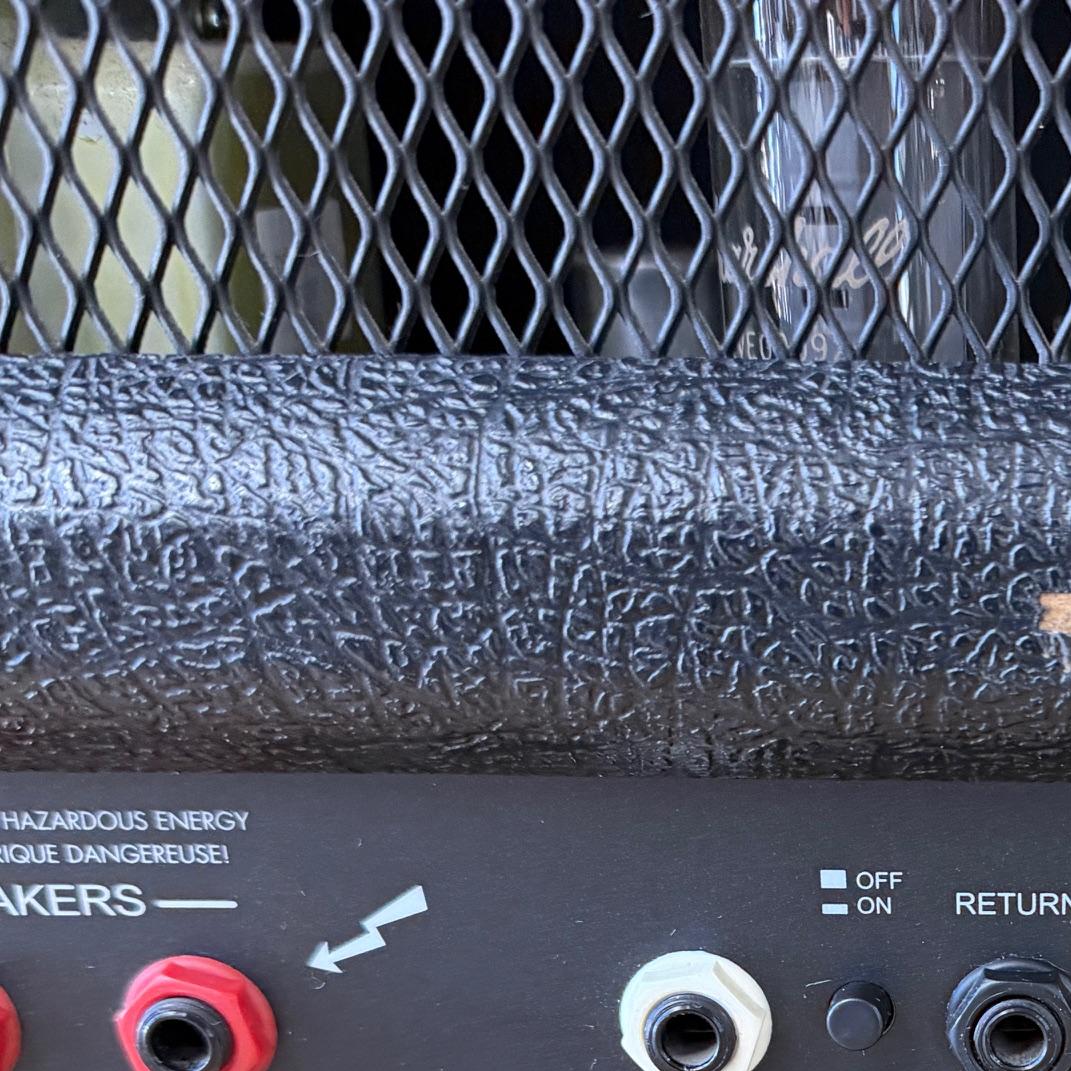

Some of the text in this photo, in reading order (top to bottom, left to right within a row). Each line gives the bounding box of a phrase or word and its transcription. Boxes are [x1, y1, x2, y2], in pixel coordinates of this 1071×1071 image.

[2, 810, 249, 831] HAZARDOUS ENERGY
[63, 844, 230, 864] DANGEREUSE!
[855, 872, 903, 890] OFF
[856, 897, 892, 915] ON
